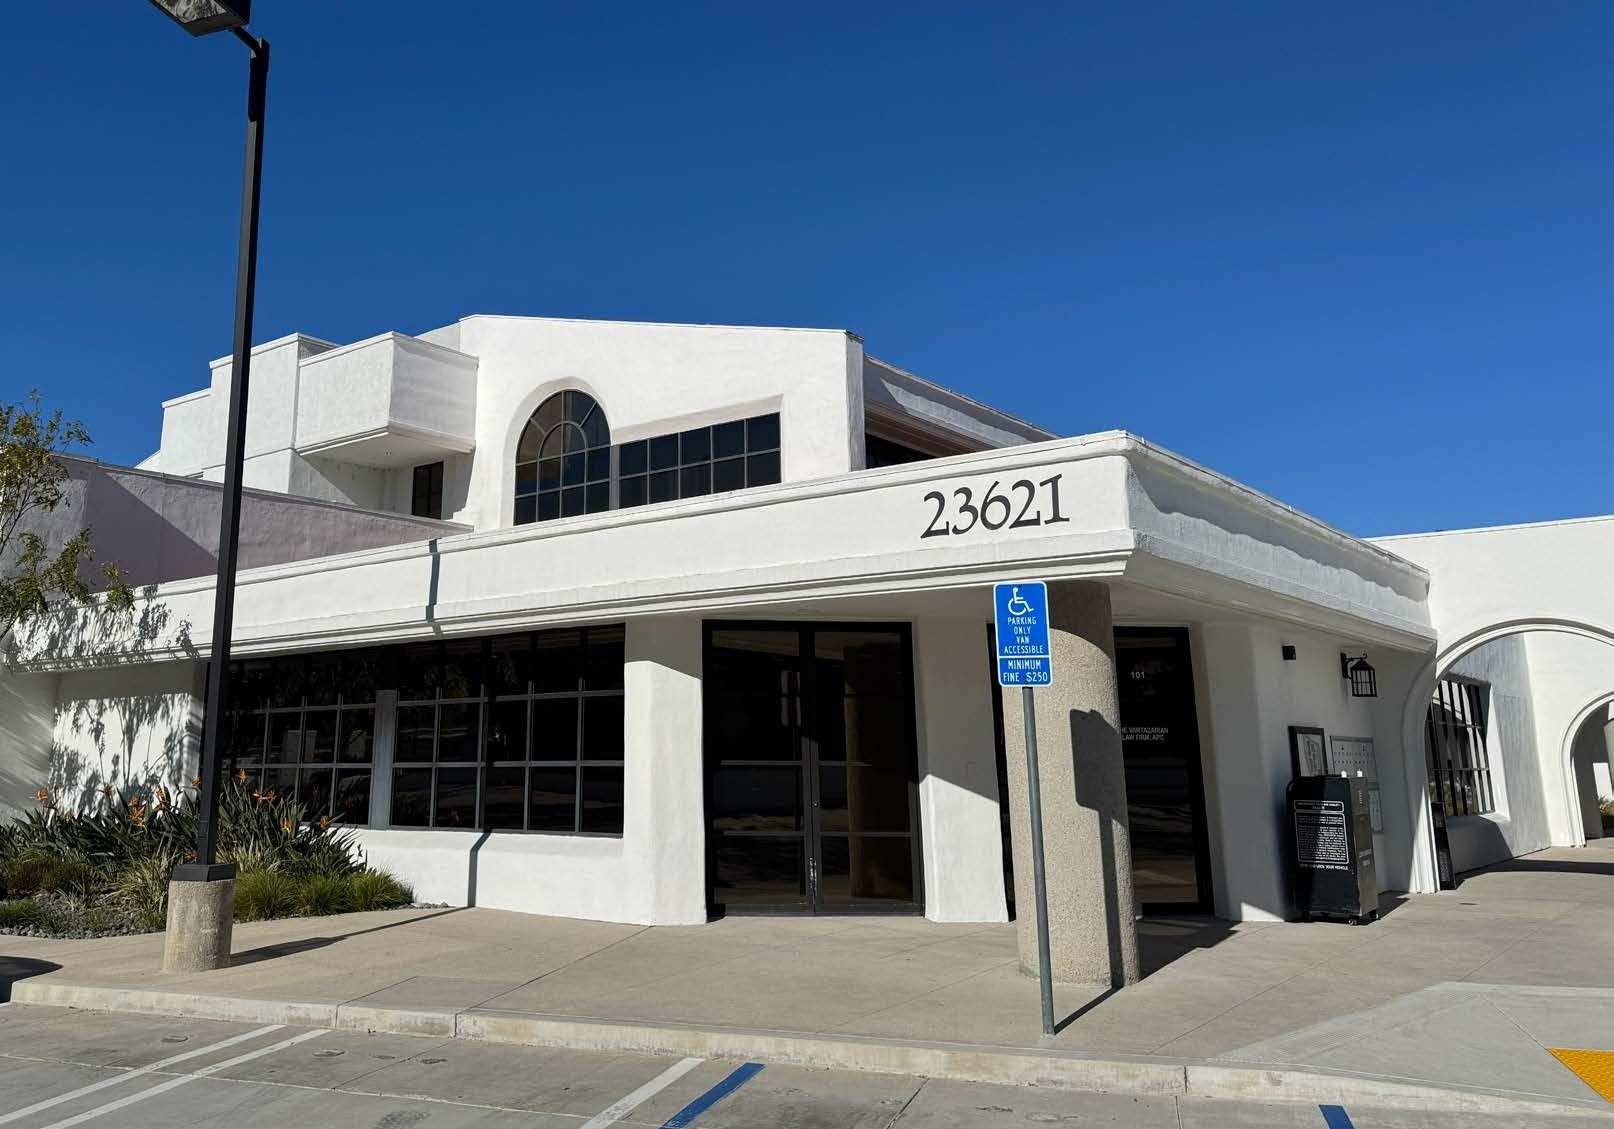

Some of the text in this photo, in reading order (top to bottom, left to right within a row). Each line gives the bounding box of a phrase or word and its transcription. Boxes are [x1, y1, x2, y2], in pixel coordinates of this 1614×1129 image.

[920, 473, 1070, 539] 23621
[1007, 616, 1037, 625] PARKING
[1013, 626, 1031, 634] ONLY
[1016, 636, 1029, 644] VAN
[1004, 645, 1044, 654] ACCESSIBLE
[1008, 659, 1042, 670] MINIMUM
[1003, 671, 1048, 682] FINE $250
[1130, 671, 1145, 679] 101
